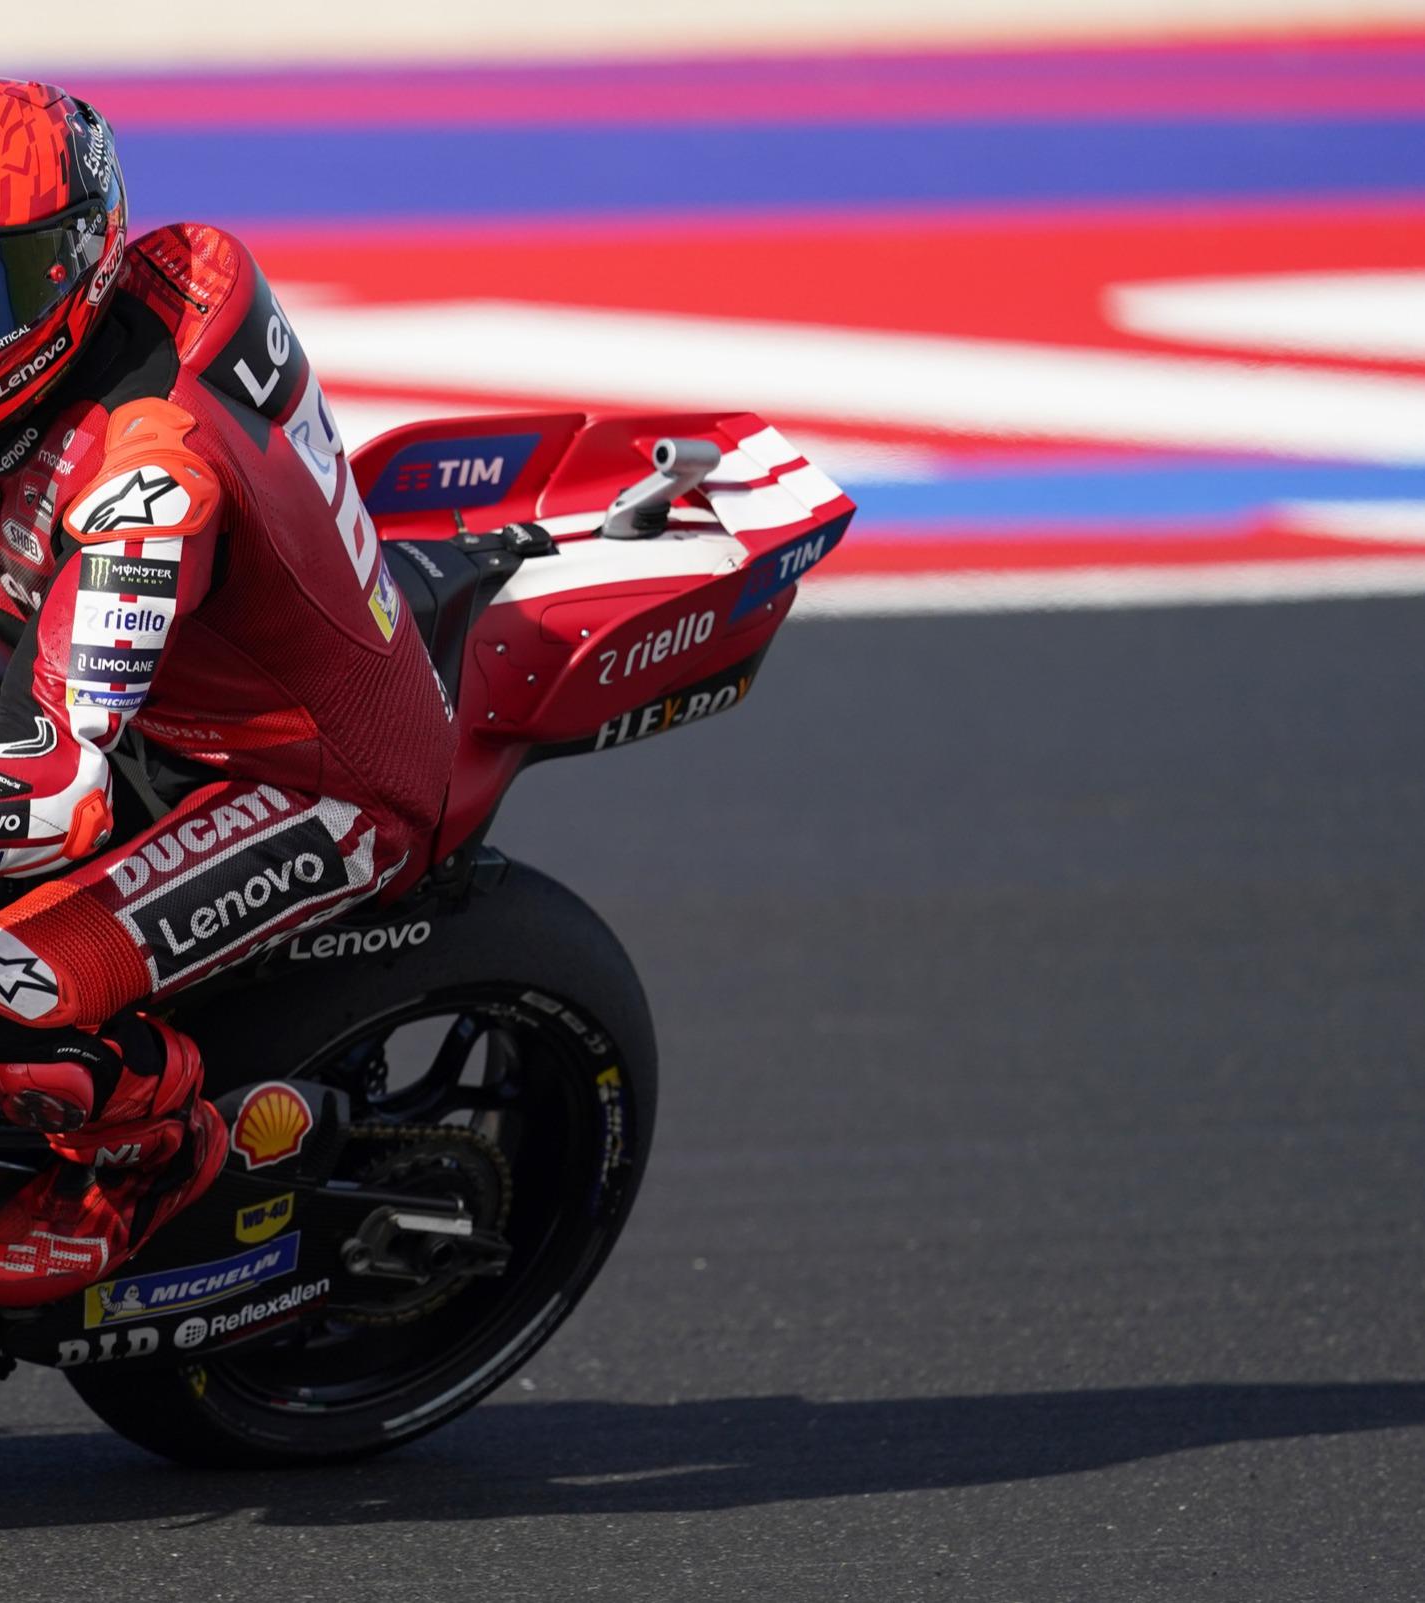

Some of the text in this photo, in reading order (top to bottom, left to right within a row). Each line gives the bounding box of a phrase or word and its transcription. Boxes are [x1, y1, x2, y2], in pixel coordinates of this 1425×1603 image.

[438, 457, 504, 489] TIM
[10, 524, 39, 560] SHOEI
[779, 536, 825, 580] TIM
[112, 564, 172, 581] MONSTER
[121, 577, 164, 586] ENERGY
[104, 607, 165, 633] riello
[624, 609, 716, 677] riello
[90, 657, 154, 673] LIMOLANE
[95, 695, 143, 707] MICHELIN
[106, 784, 291, 898] DUCATI
[158, 853, 325, 956] Lenovo
[289, 920, 431, 960] Lenovo
[242, 1199, 289, 1230] WD-40
[150, 1252, 281, 1303] MICHELIN
[210, 1278, 330, 1337] Reflexallen
